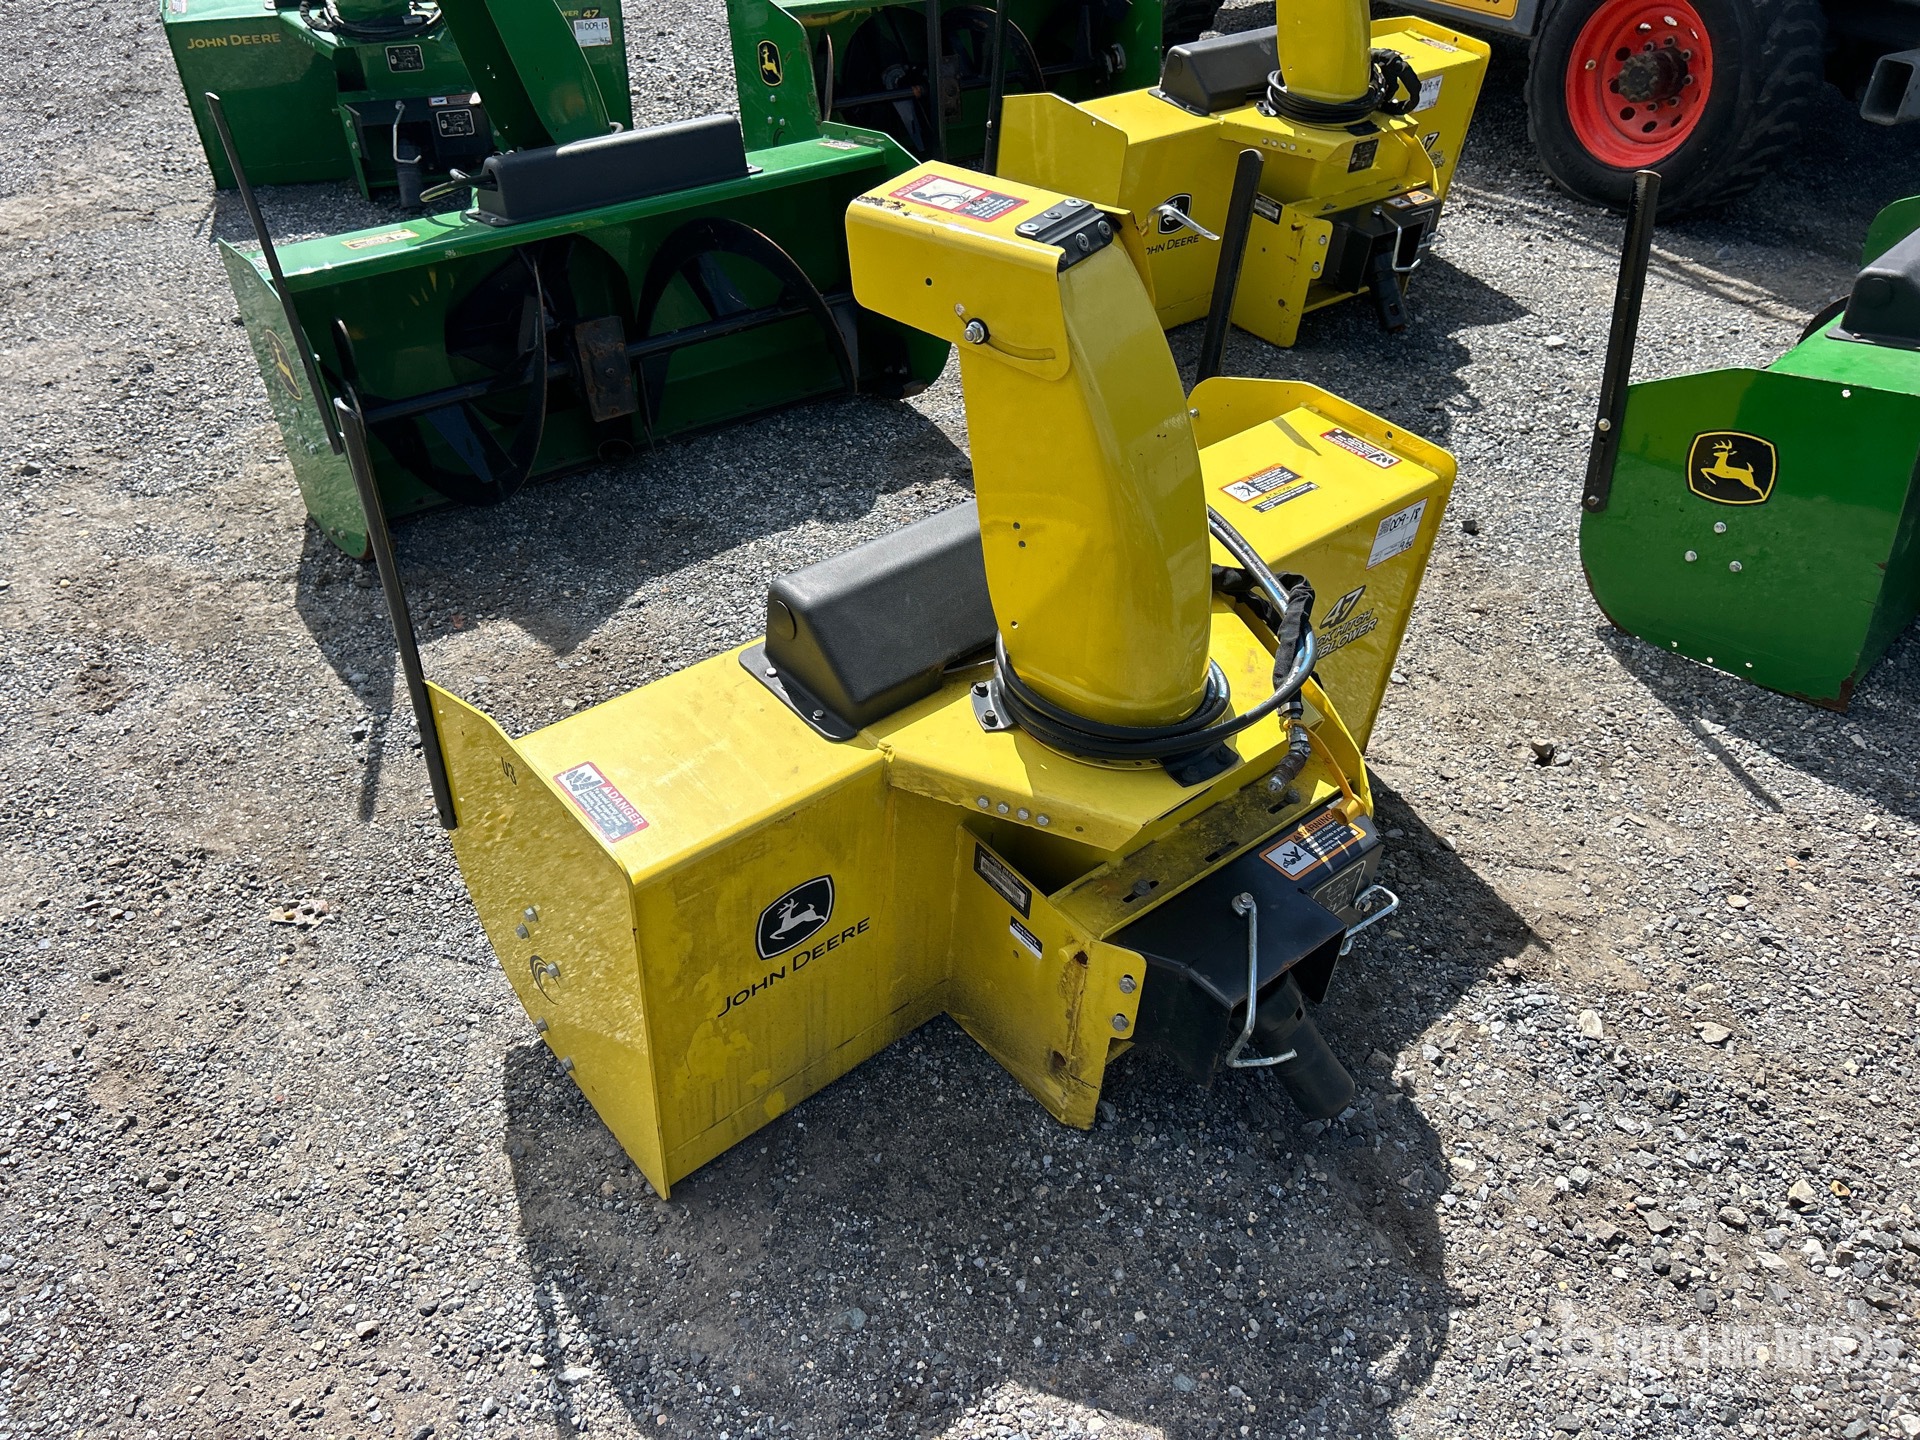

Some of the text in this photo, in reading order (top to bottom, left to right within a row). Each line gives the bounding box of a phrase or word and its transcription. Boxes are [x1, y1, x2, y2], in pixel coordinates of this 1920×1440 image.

[582, 9, 599, 18] 47
[187, 33, 281, 50] JOHN DEERE
[902, 174, 937, 193] DANGER
[1166, 234, 1200, 250] DEERE
[1319, 584, 1366, 629] 47
[1334, 608, 1374, 638] HITCH
[608, 791, 645, 827] DANGER
[1301, 814, 1334, 838] WARNING
[717, 917, 870, 1018] JOHN DEERE
